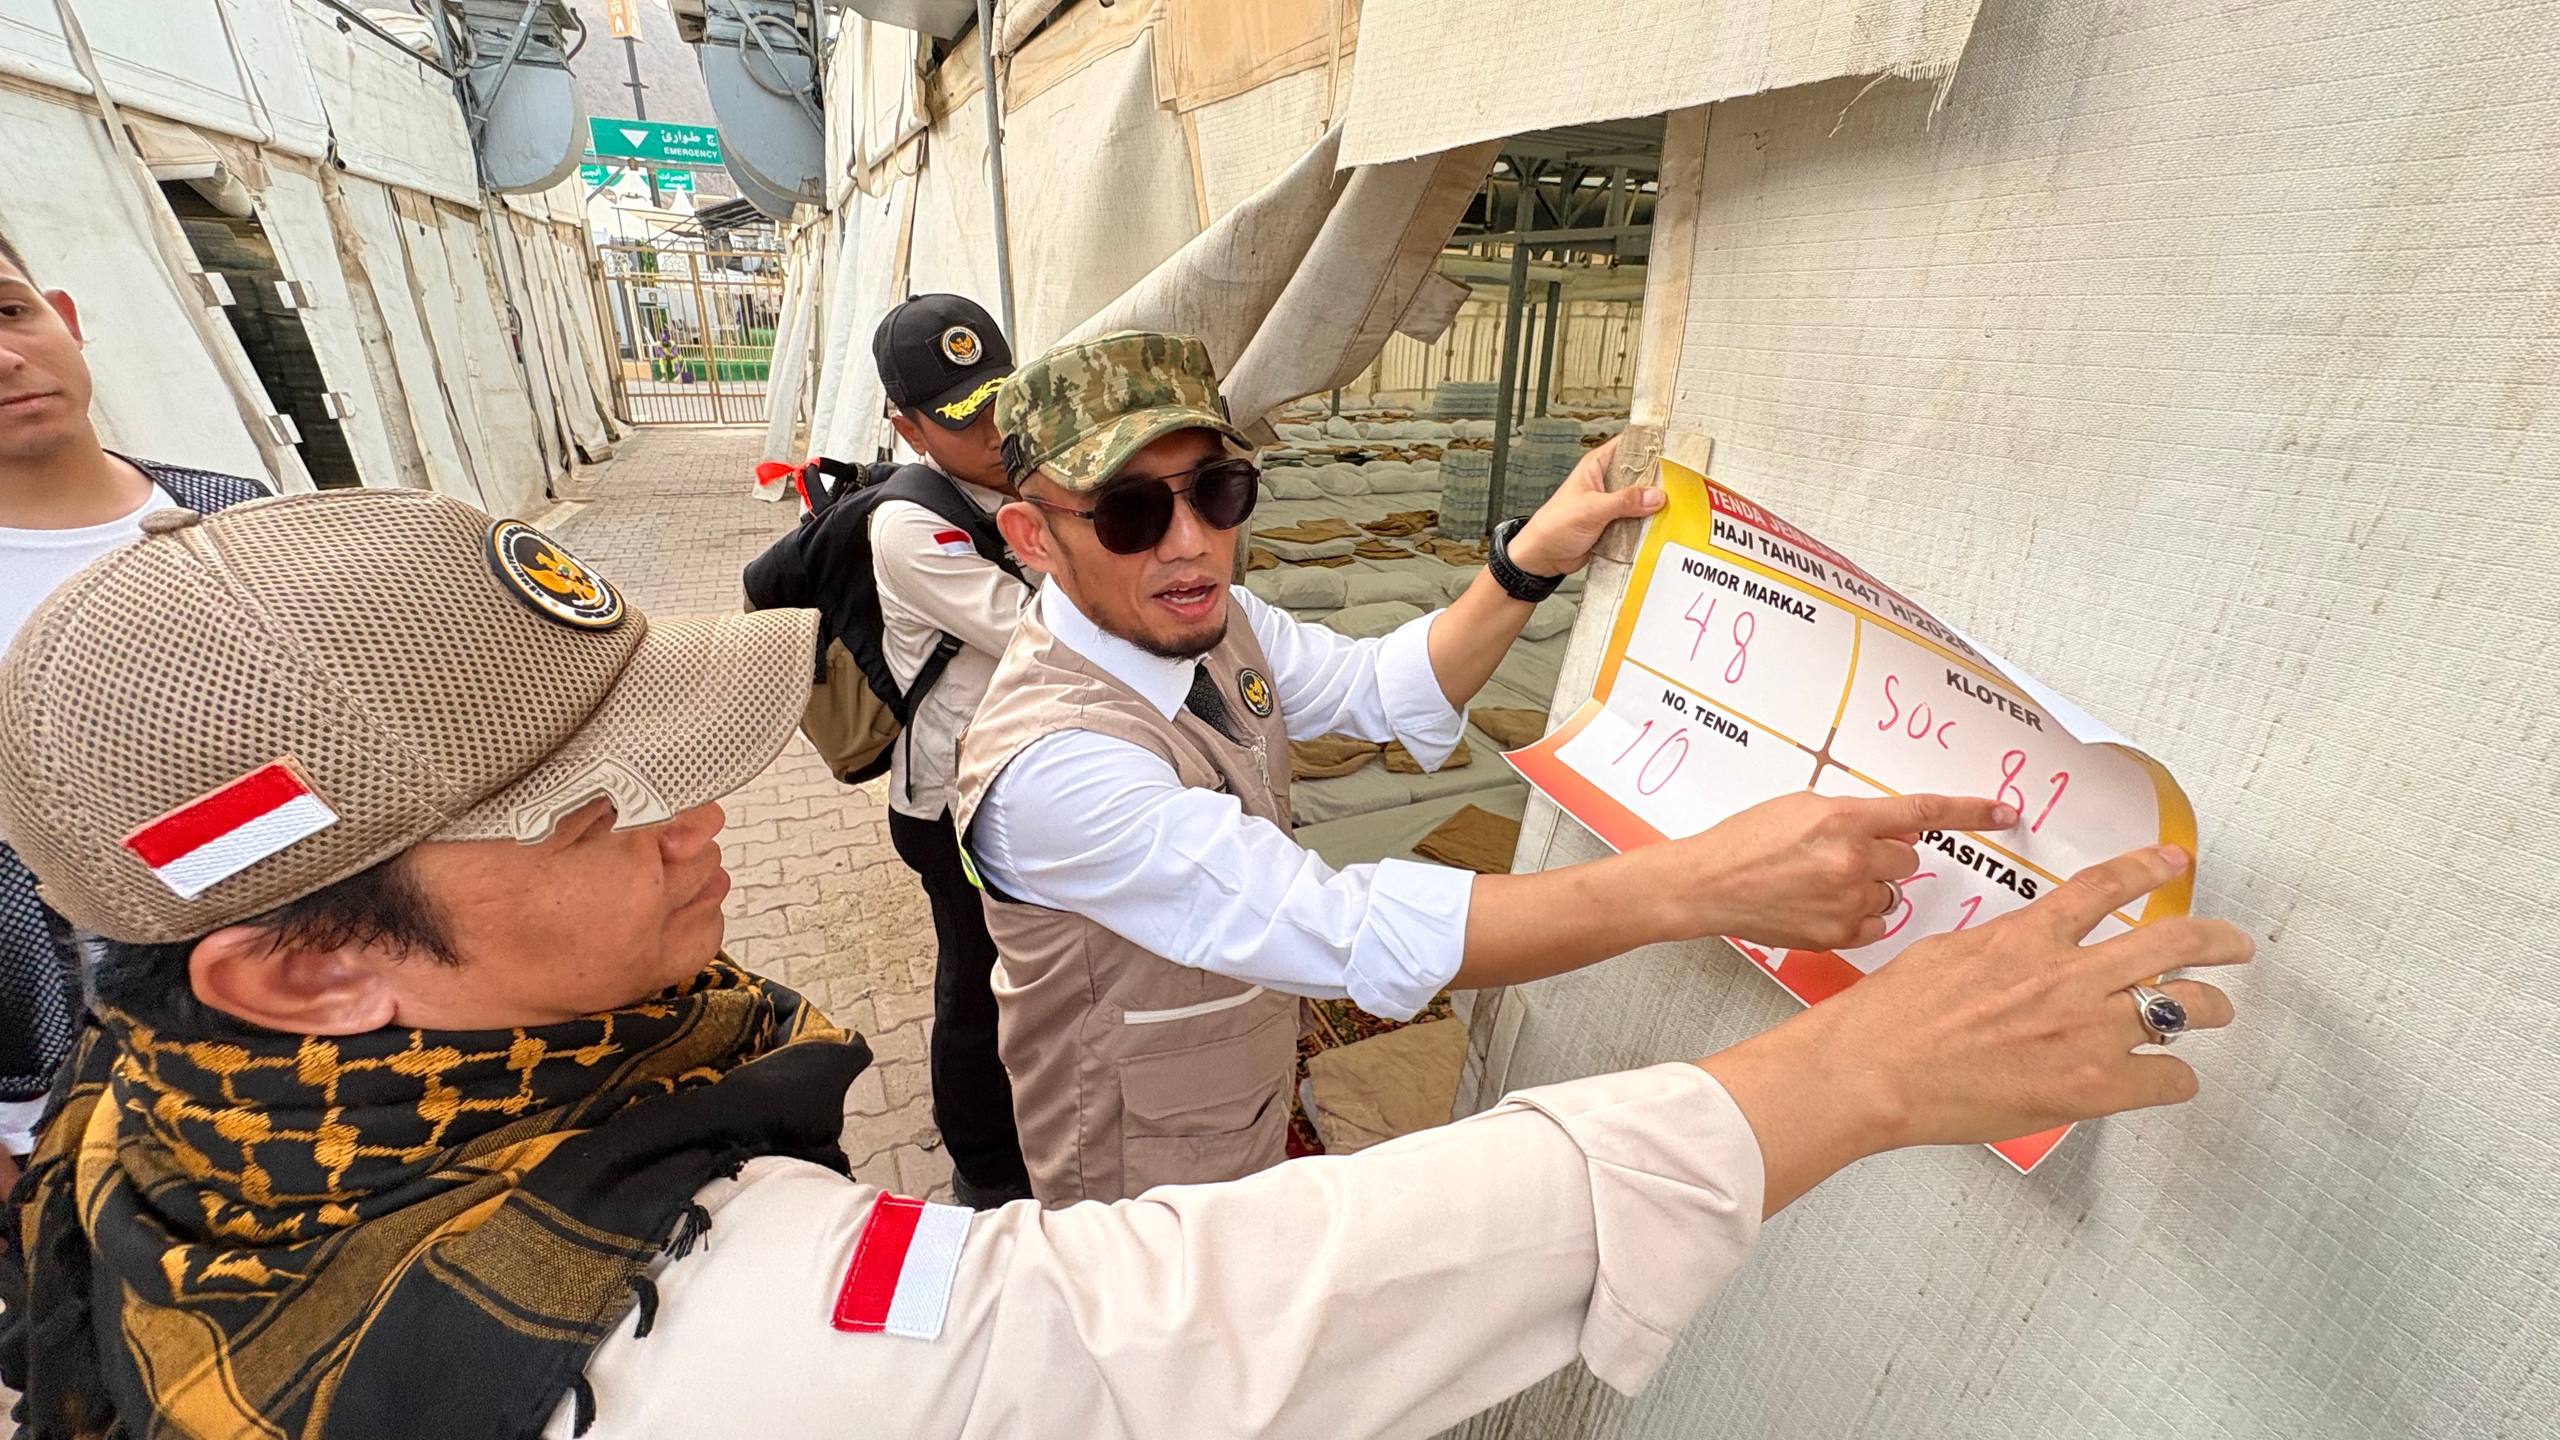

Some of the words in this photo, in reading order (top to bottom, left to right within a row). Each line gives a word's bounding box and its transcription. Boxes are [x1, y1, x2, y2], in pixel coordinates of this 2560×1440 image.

[663, 146, 718, 159] EMERGENCY
[1708, 485, 1767, 525] TENDA
[1681, 557, 1740, 592] NOMOR
[1743, 580, 1817, 624] MARKAZ
[1713, 518, 1754, 550] HAJI
[1758, 536, 1827, 582] TAHUN
[1832, 571, 1881, 607] 1447
[1684, 591, 1755, 684] 48
[1661, 689, 1688, 714] NO.
[1694, 705, 1750, 747] TENDA
[1945, 668, 2044, 733] KLOTER
[1611, 719, 1689, 796] 10
